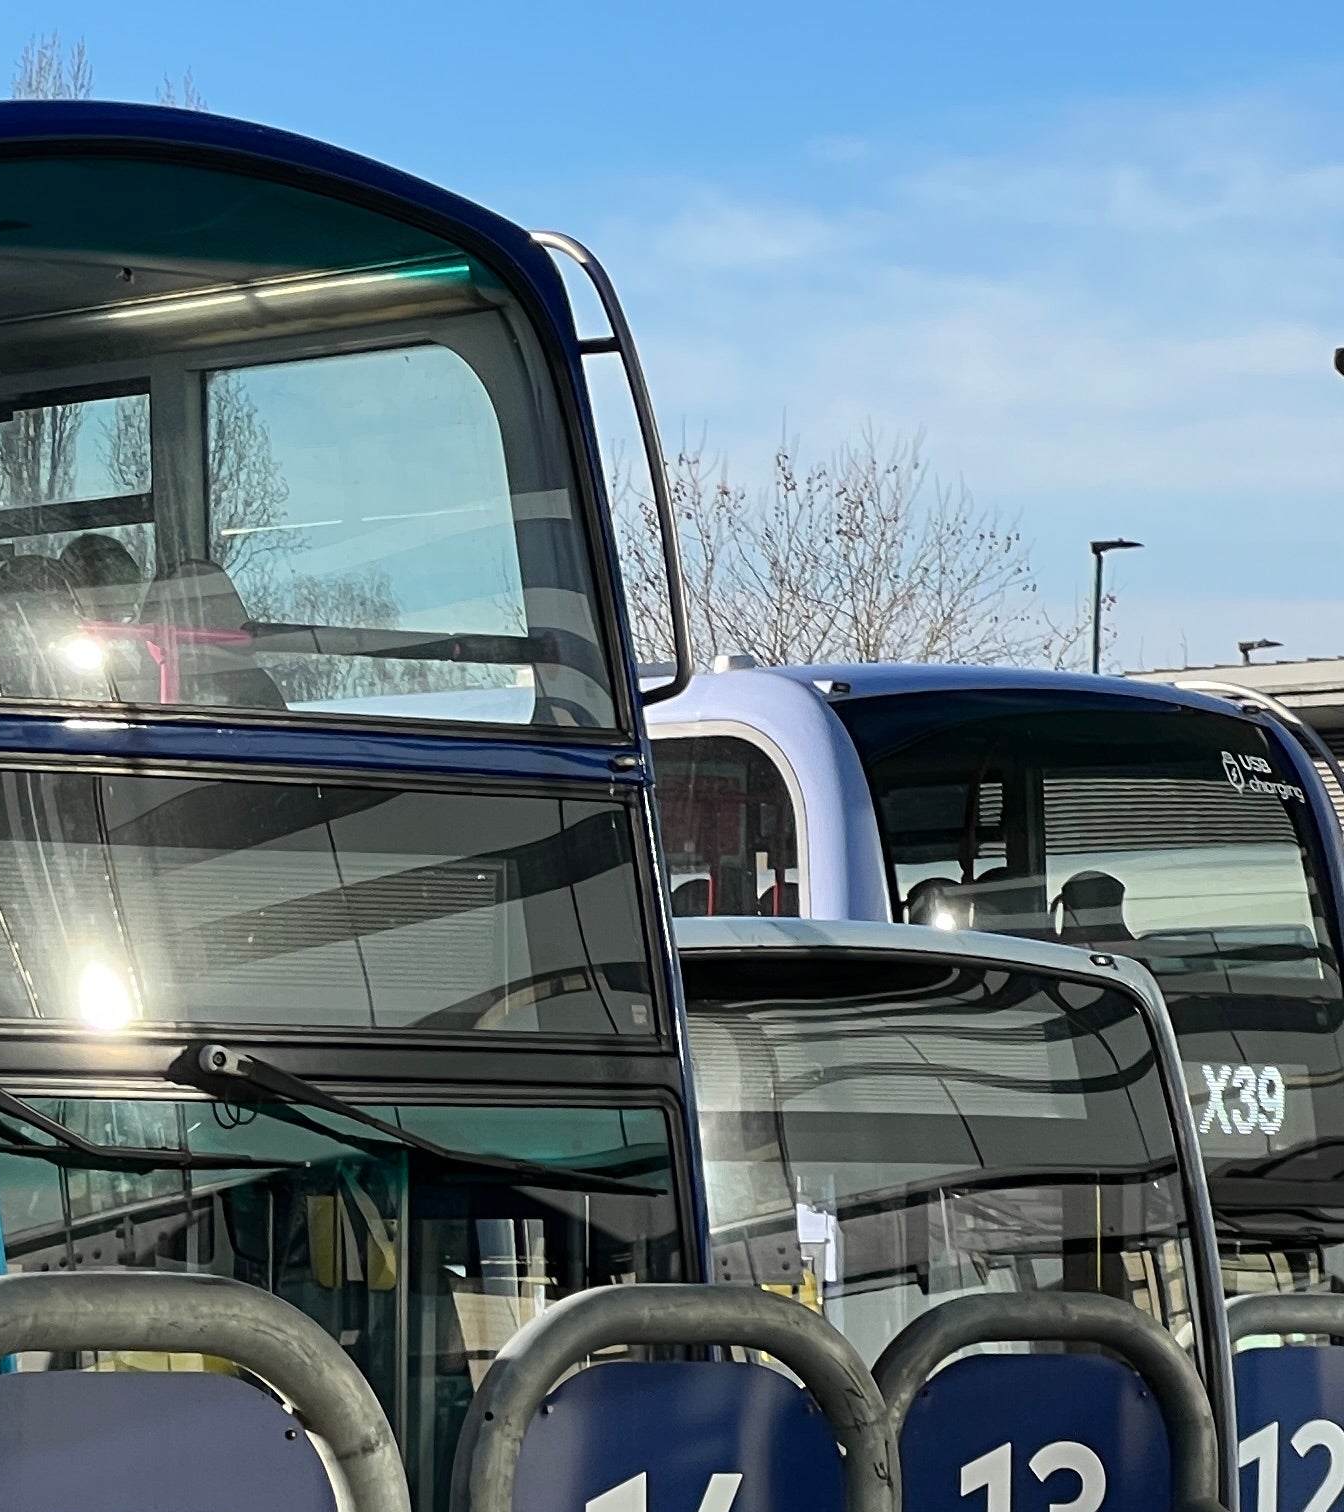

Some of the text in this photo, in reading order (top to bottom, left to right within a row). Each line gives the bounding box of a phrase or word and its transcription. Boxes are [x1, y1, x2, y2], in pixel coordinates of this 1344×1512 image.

[1237, 753, 1272, 773] USB
[1248, 774, 1305, 804] charging
[1197, 1063, 1286, 1137] X39
